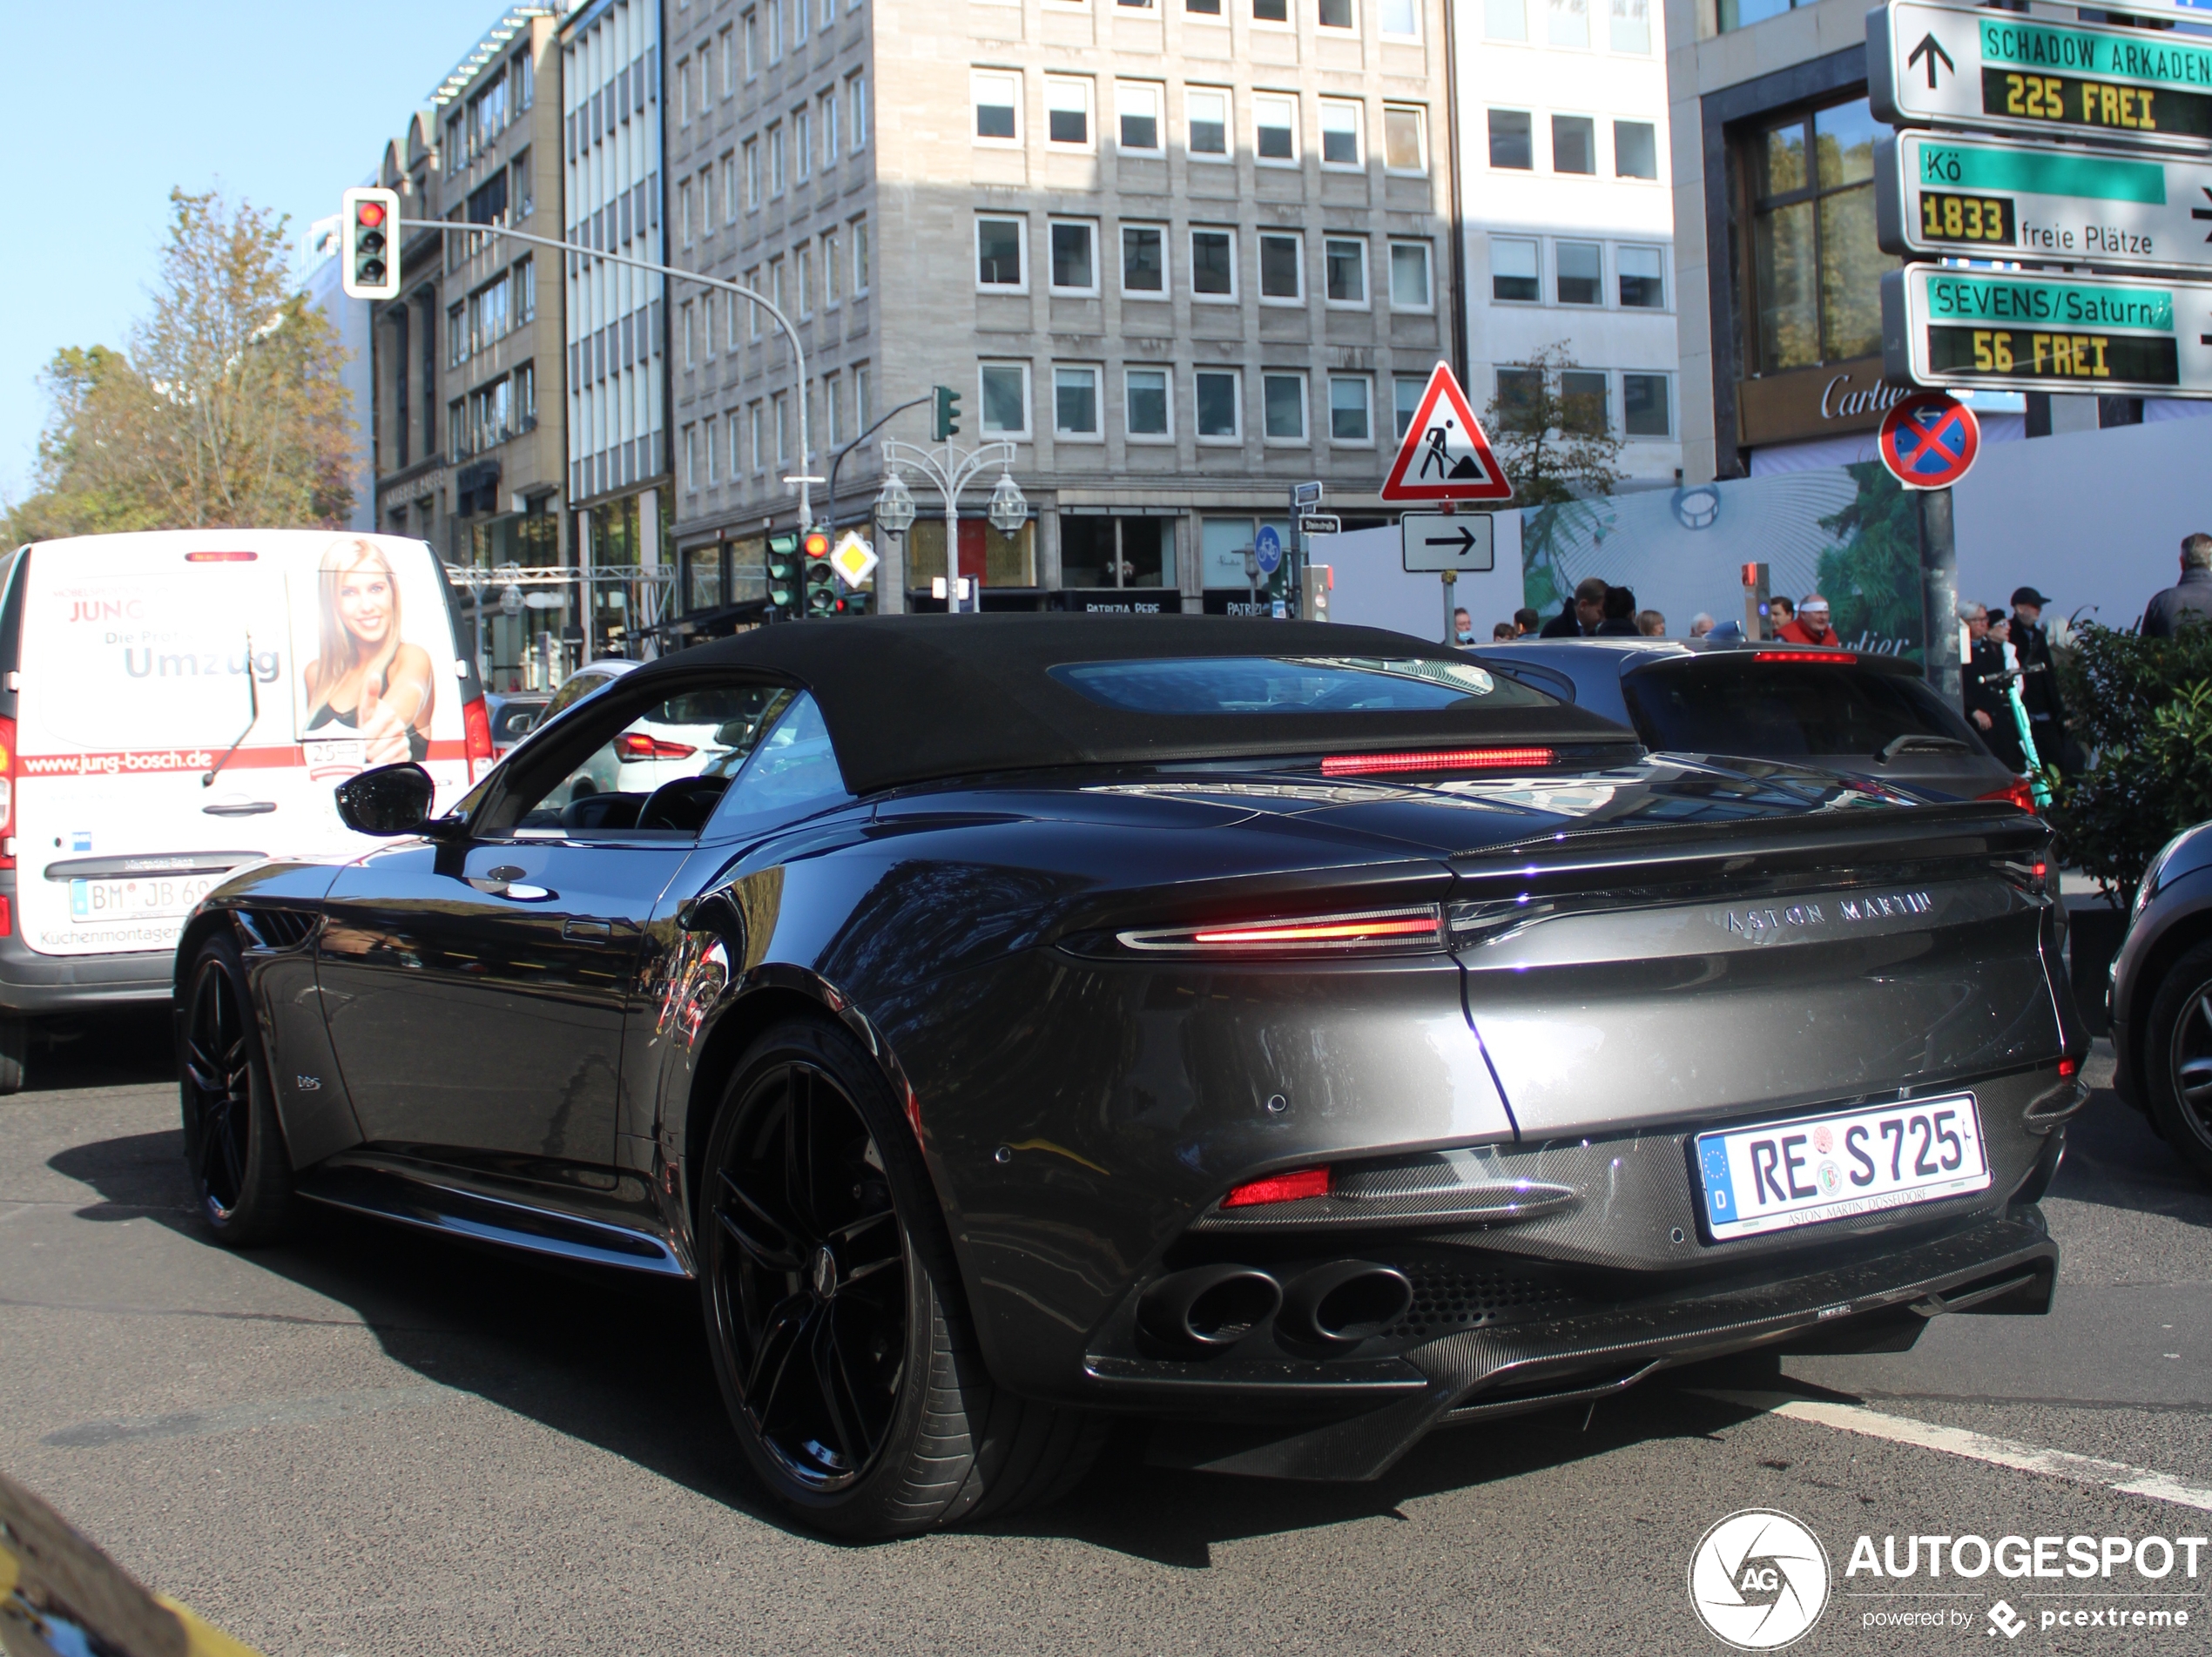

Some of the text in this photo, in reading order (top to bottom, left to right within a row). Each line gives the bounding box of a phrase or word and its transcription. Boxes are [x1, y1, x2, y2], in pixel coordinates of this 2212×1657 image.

[1987, 28, 2210, 83] SCHADOW ARKADEN
[2006, 74, 2155, 129] 225 FREI
[1927, 152, 1961, 181] Kö
[1924, 196, 2153, 253] 1833 freie Plätze
[1937, 283, 2153, 326] SEVENS/Saturn
[1973, 330, 2110, 377] 56 FREI
[1821, 374, 1912, 419] Cartie
[69, 599, 145, 623] JUNG
[105, 631, 135, 645] Die
[125, 647, 280, 684] Umzug
[24, 751, 212, 775] www.jung-bosch.de
[314, 744, 335, 762] 25
[92, 884, 124, 910] BM
[1729, 891, 1934, 933] ASTON MARTIN
[1750, 1135, 1817, 1204] RE
[1716, 1189, 1726, 1209] D
[1788, 1189, 1927, 1226] ASTON MARTIN DÜSSELDORF
